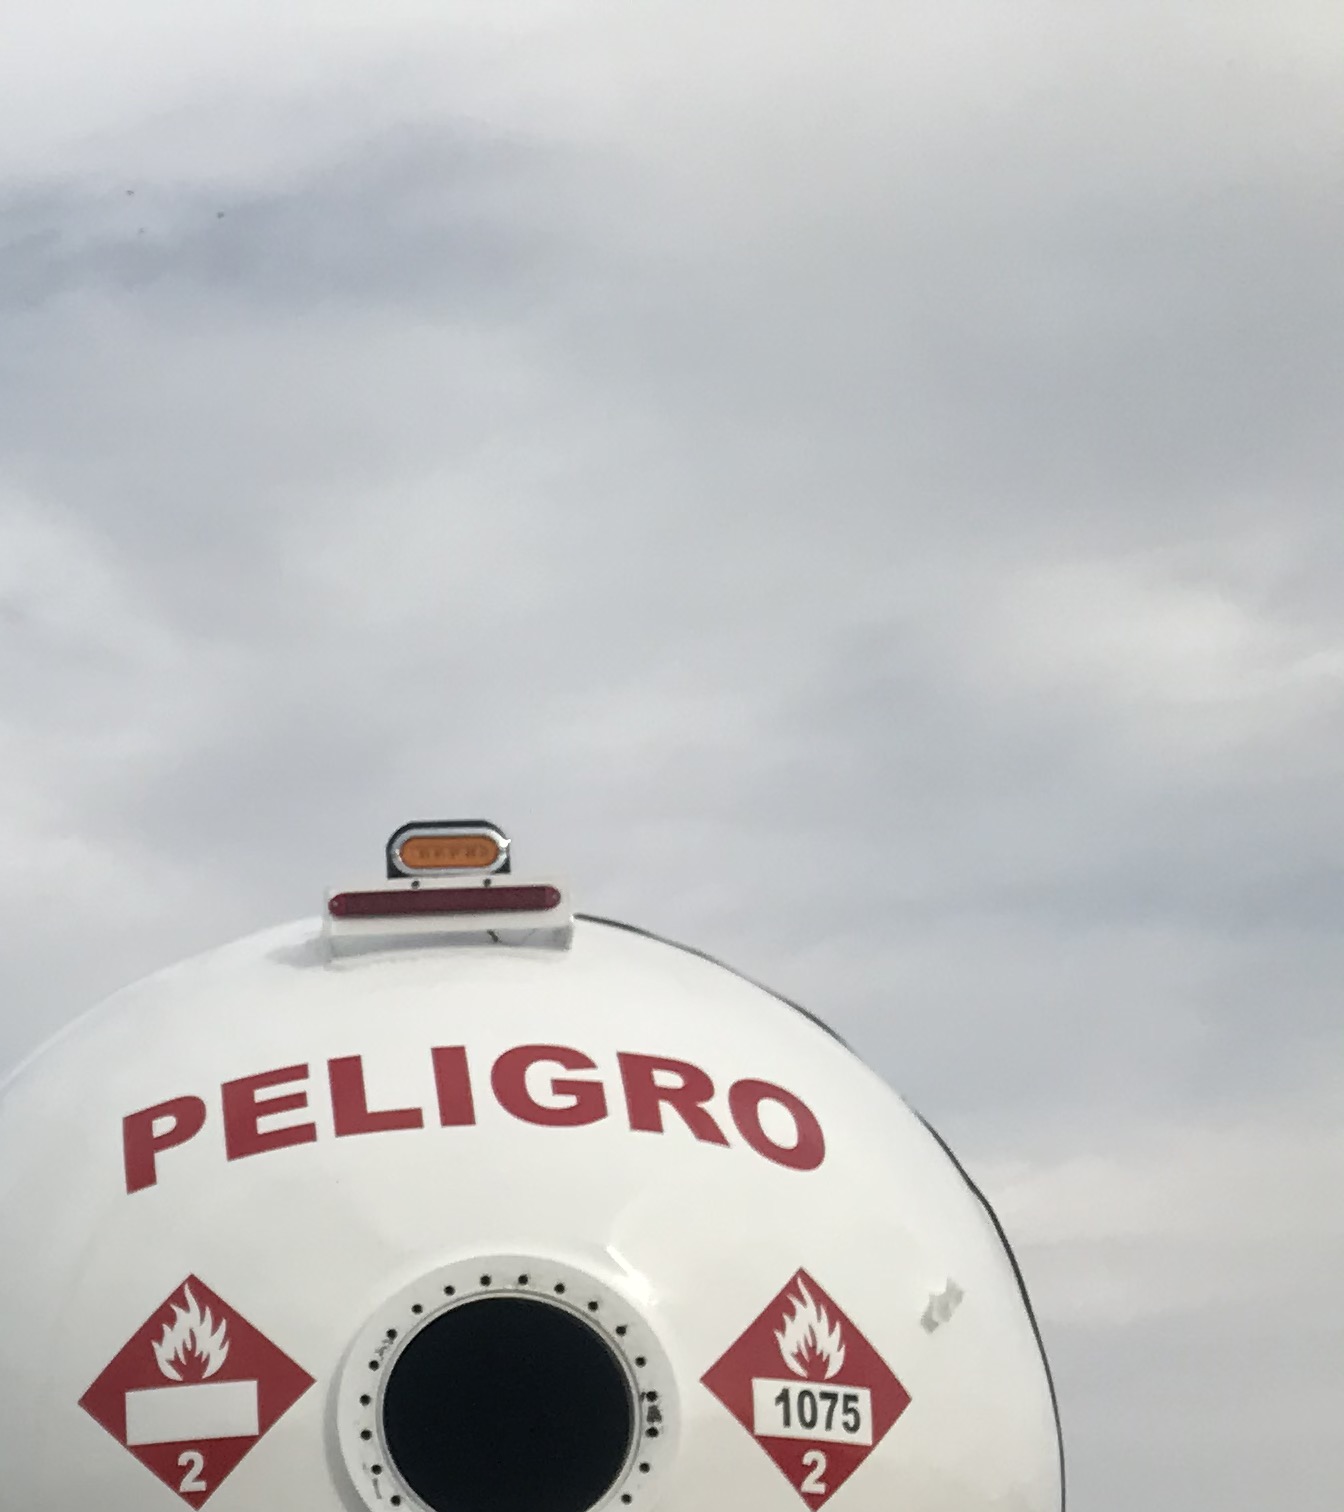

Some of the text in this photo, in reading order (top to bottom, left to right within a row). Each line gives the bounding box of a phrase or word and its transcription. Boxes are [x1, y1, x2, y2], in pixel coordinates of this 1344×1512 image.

[123, 1043, 826, 1194] PELIGRO
[775, 1387, 862, 1434] 1075
[178, 1450, 207, 1493] 2
[801, 1449, 826, 1494] 2
